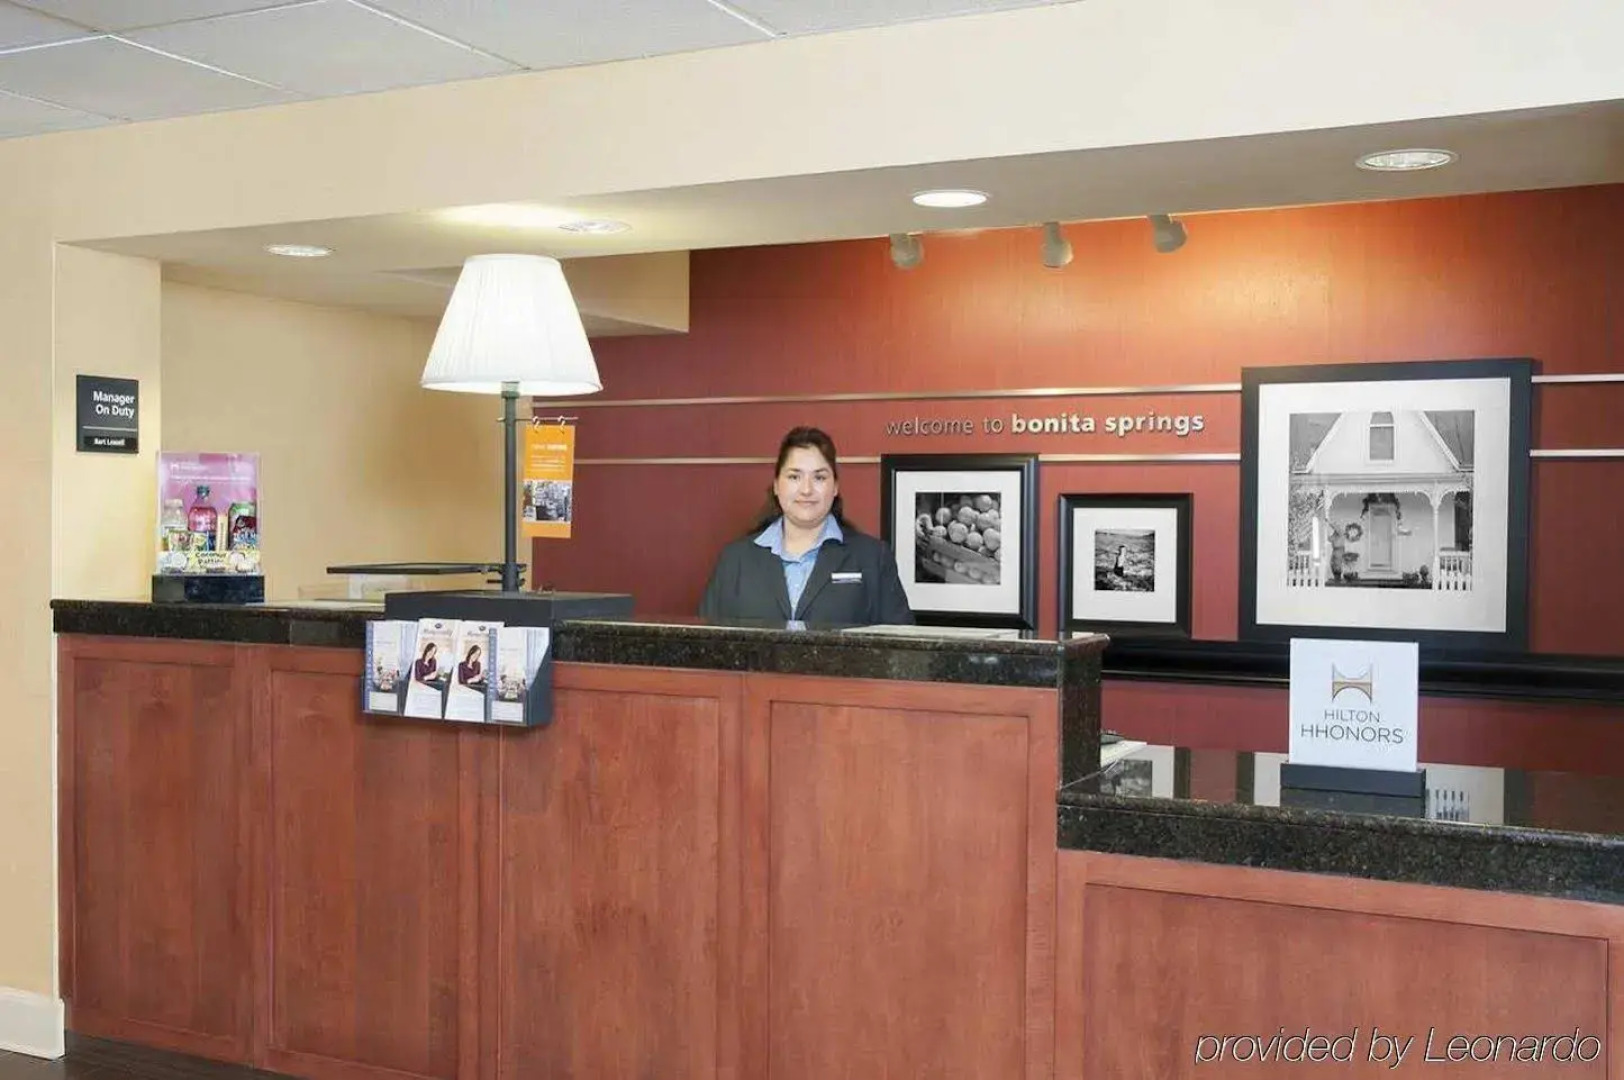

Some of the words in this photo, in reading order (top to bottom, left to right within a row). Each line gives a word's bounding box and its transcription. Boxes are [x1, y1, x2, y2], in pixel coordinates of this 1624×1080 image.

[93, 391, 135, 406] Manager
[95, 403, 110, 415] On
[111, 404, 135, 419] Duty
[885, 416, 974, 435] welcome
[982, 417, 1004, 434] to
[1010, 413, 1097, 433] bonita
[1104, 411, 1205, 437] springs
[1324, 709, 1380, 723] HILTON
[1300, 723, 1404, 745] HHONORS
